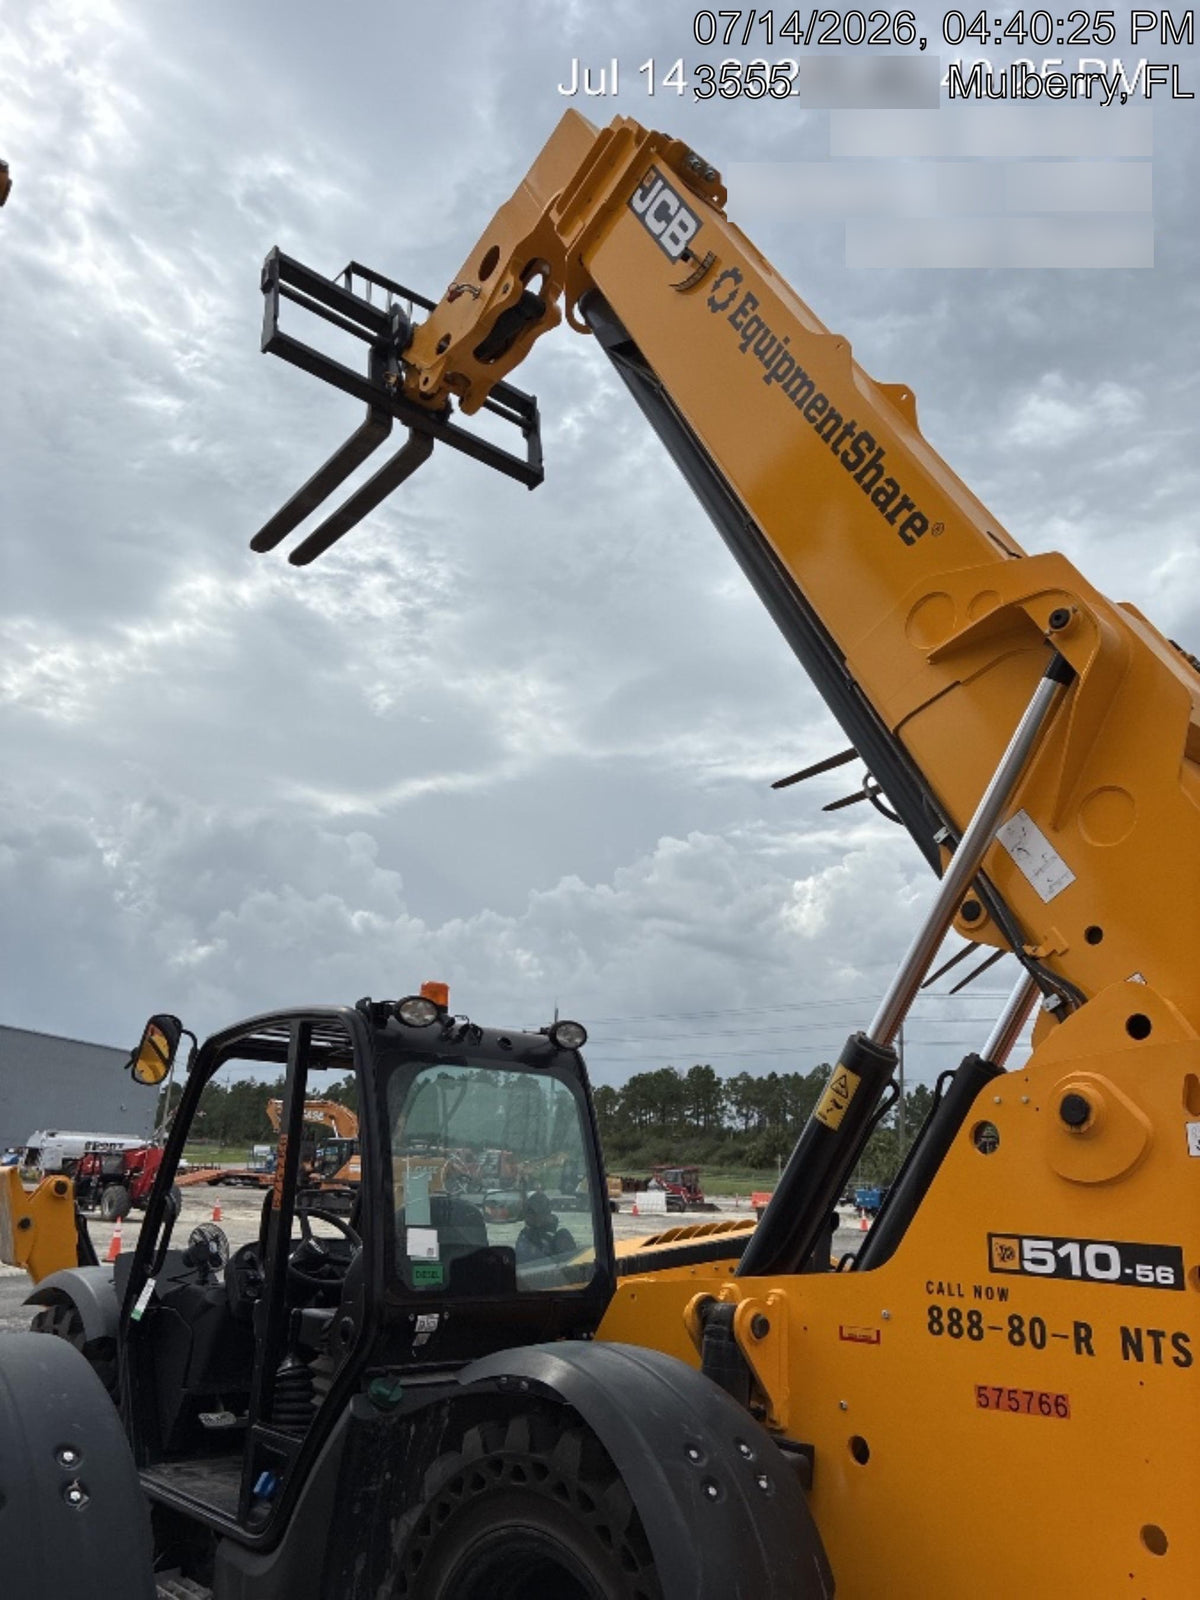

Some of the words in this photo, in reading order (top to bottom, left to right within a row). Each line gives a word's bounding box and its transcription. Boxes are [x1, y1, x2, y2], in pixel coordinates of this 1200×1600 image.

[632, 179, 699, 258] JCB
[726, 287, 930, 547] EquipmentShare
[926, 1280, 965, 1298] CALL
[973, 1285, 1010, 1302] NOW
[976, 1386, 1069, 1417] 575766
